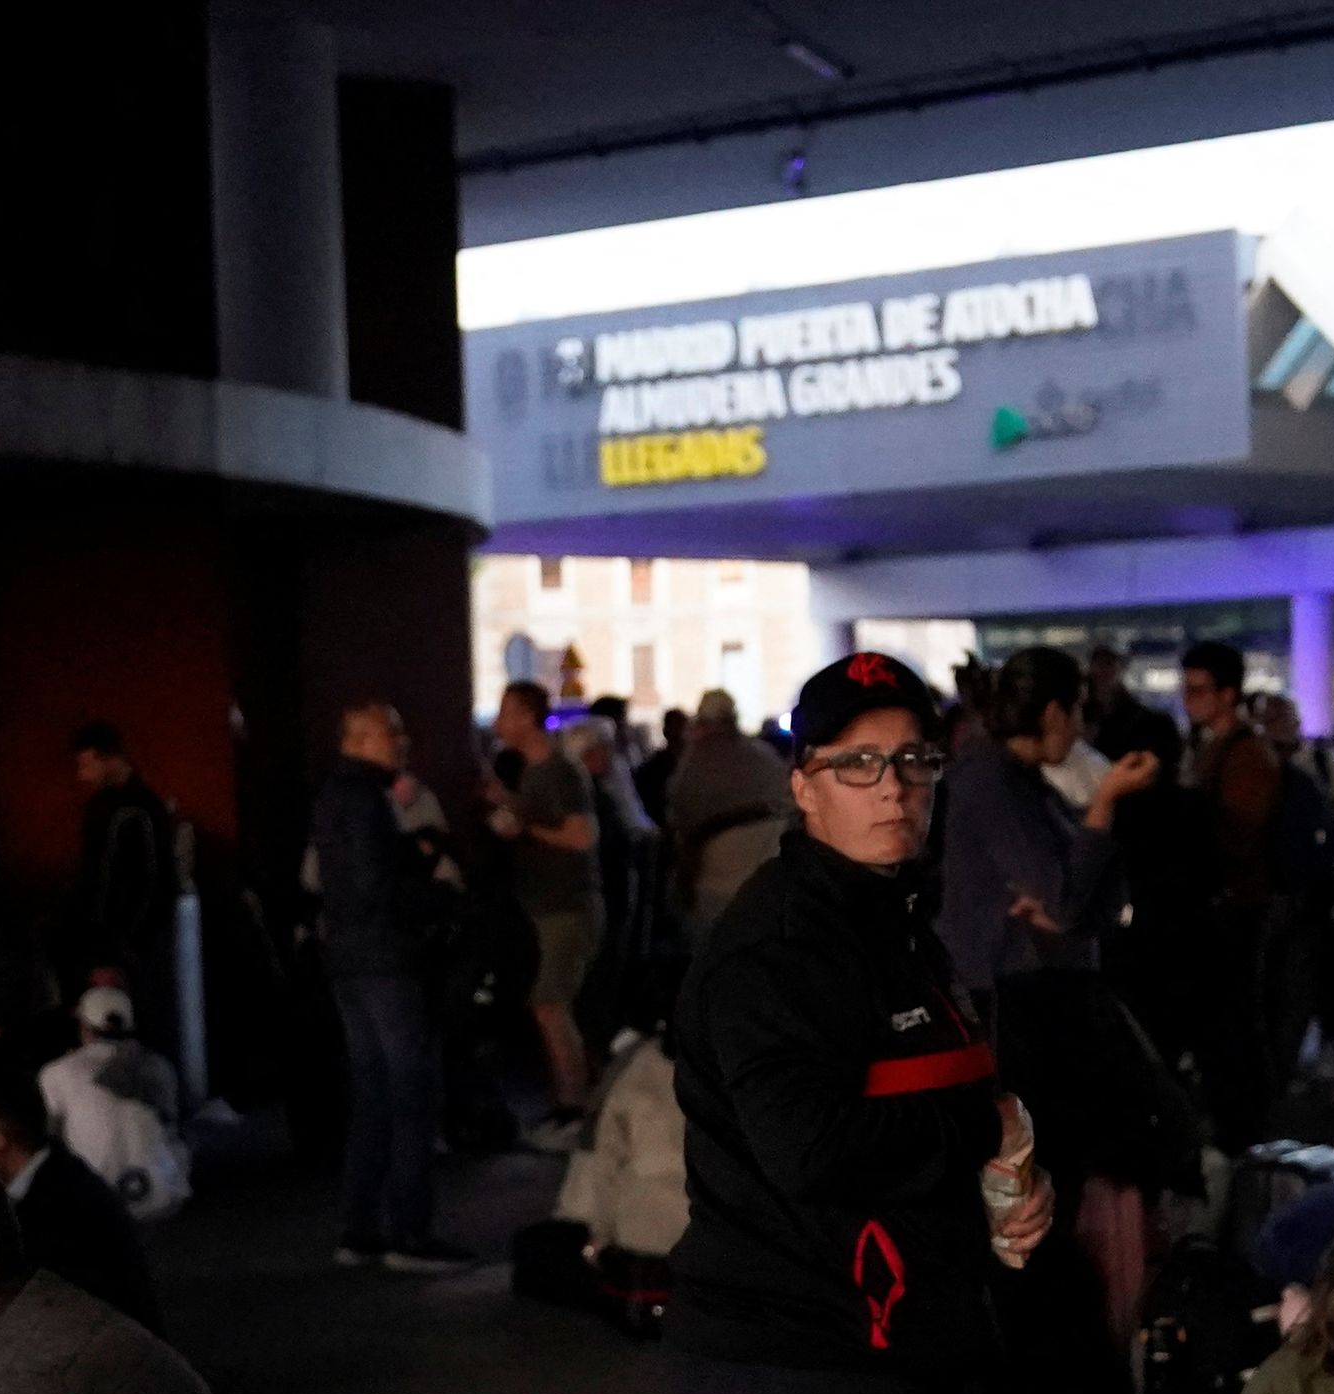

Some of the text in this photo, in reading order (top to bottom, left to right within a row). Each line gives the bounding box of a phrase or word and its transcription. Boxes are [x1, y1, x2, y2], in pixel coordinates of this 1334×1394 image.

[882, 291, 941, 351] DE
[941, 273, 1099, 343] ATOCHA
[789, 347, 962, 417] GRANDES
[599, 425, 766, 487] LLEGADAS
